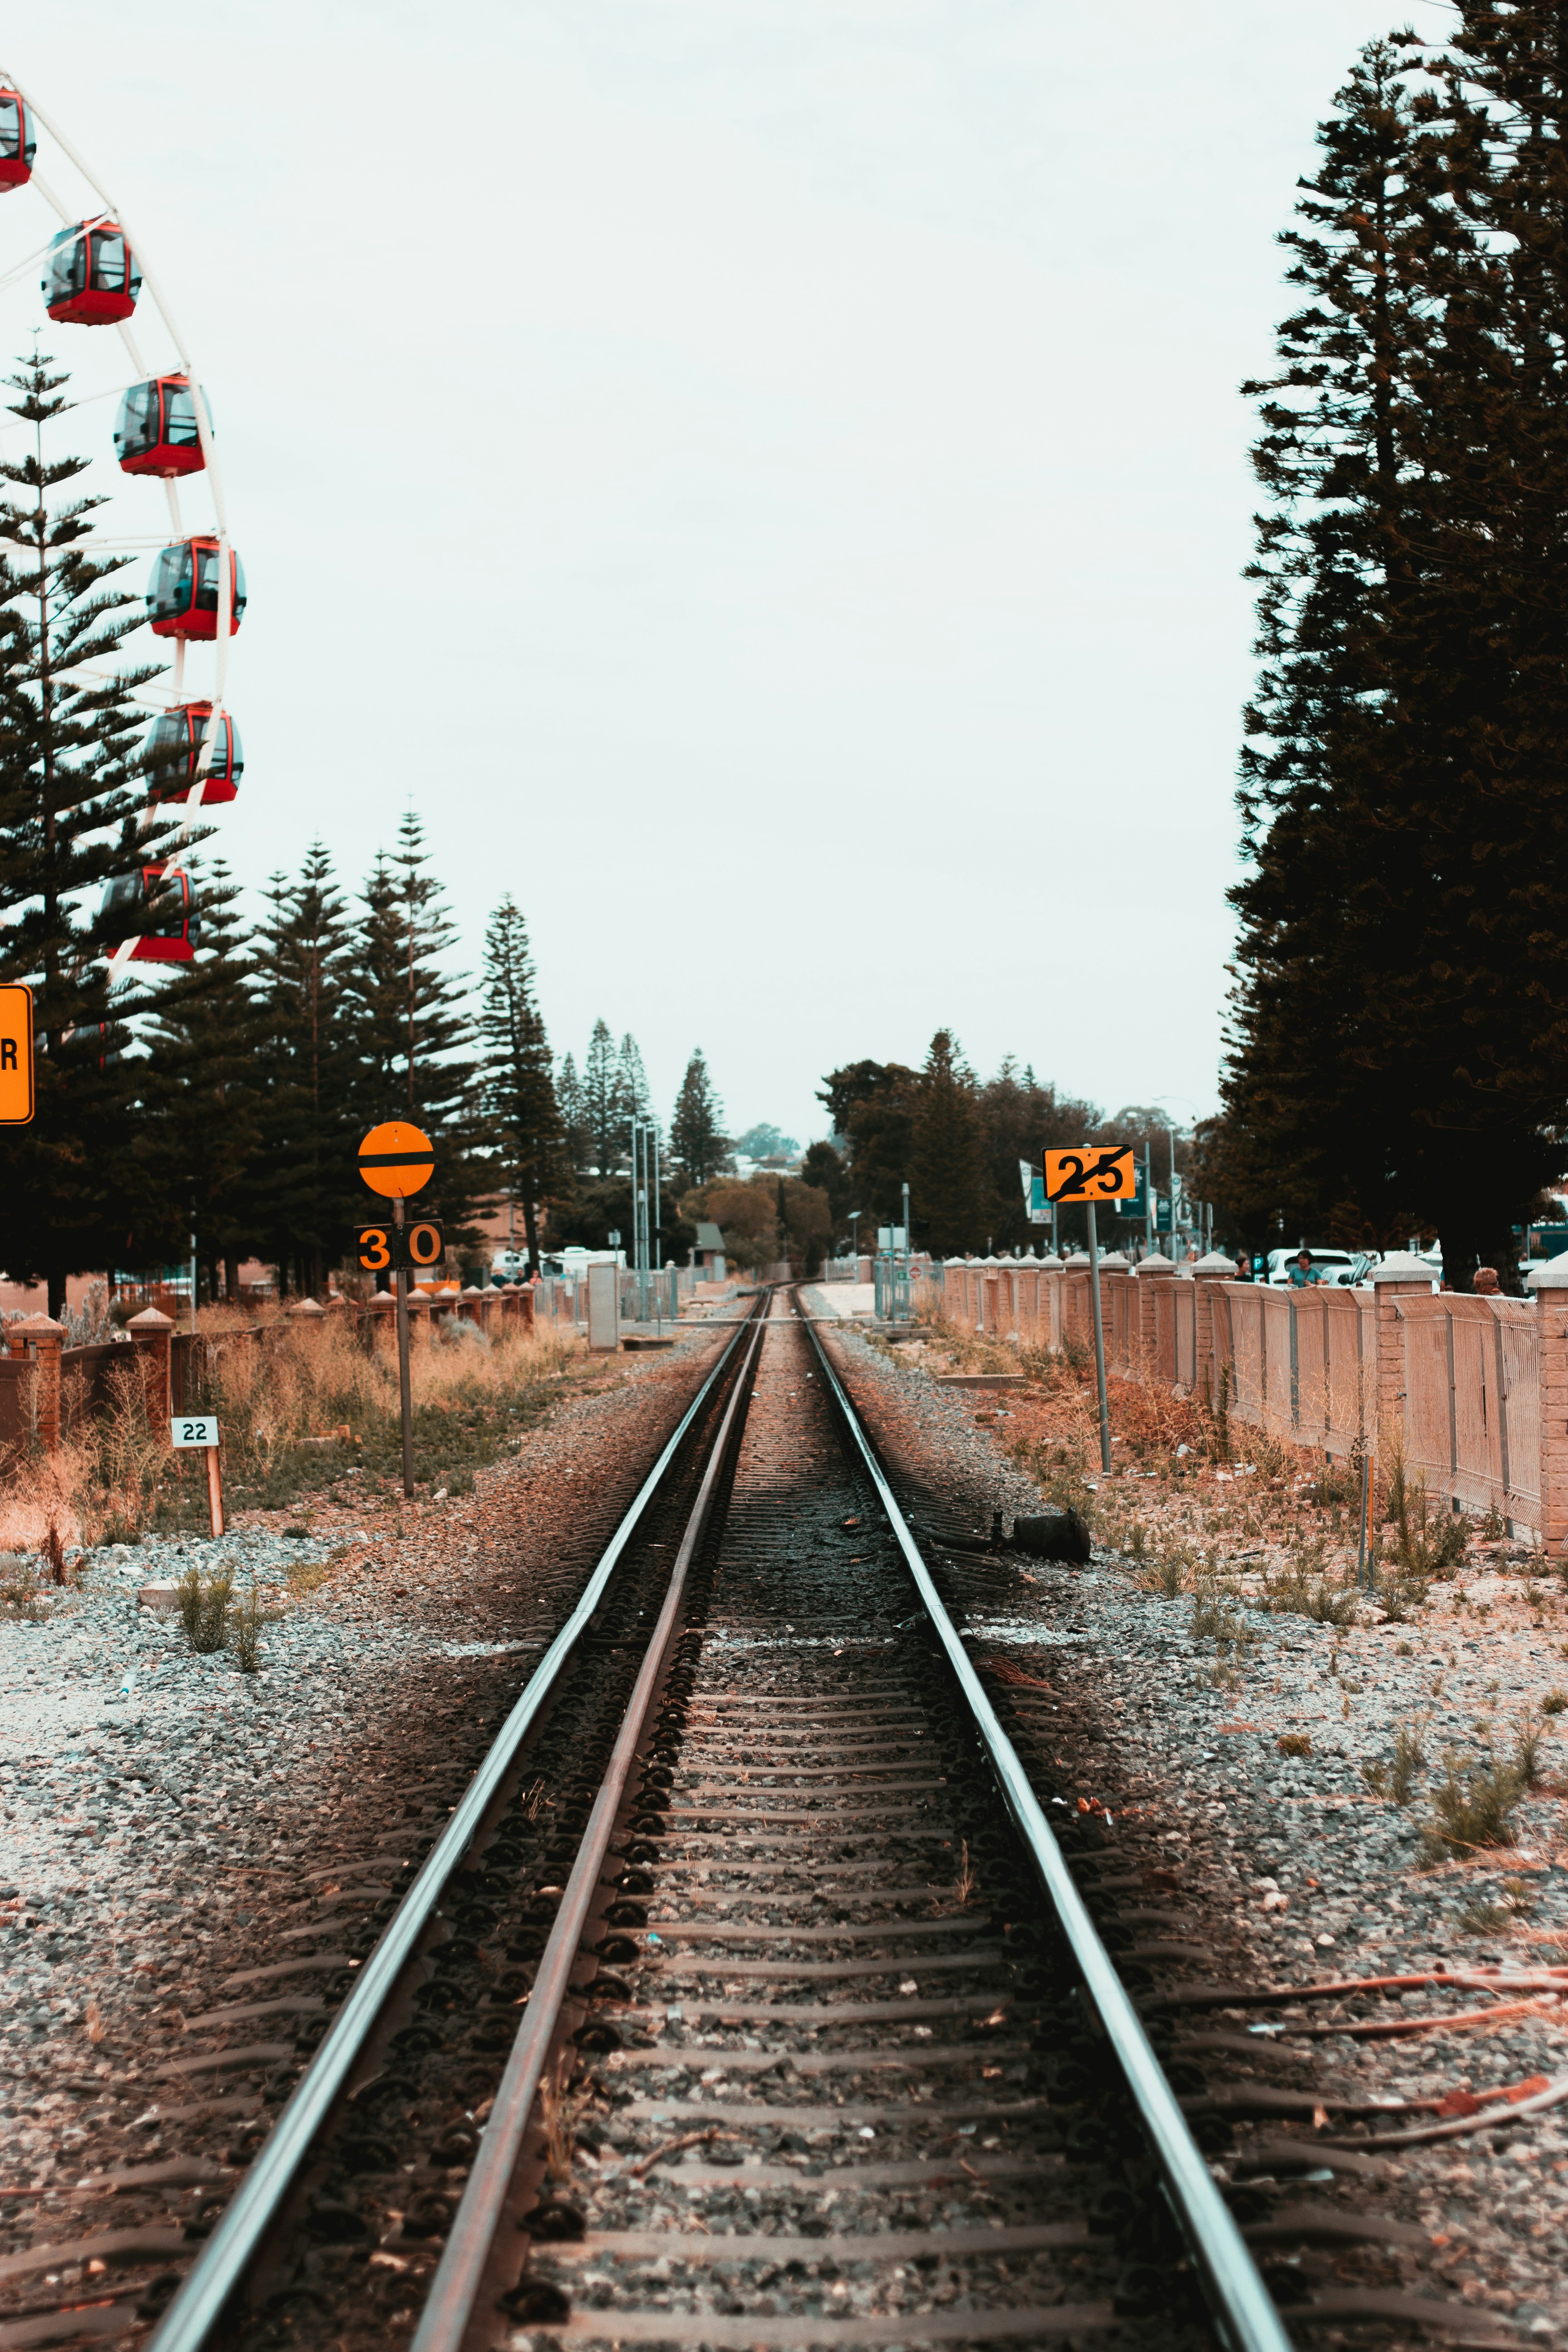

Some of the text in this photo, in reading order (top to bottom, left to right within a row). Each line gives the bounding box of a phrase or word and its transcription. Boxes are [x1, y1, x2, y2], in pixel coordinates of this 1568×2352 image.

[1058, 1154, 1123, 1194] 25
[1255, 1259, 1261, 1268] P
[183, 1423, 207, 1440] 22
